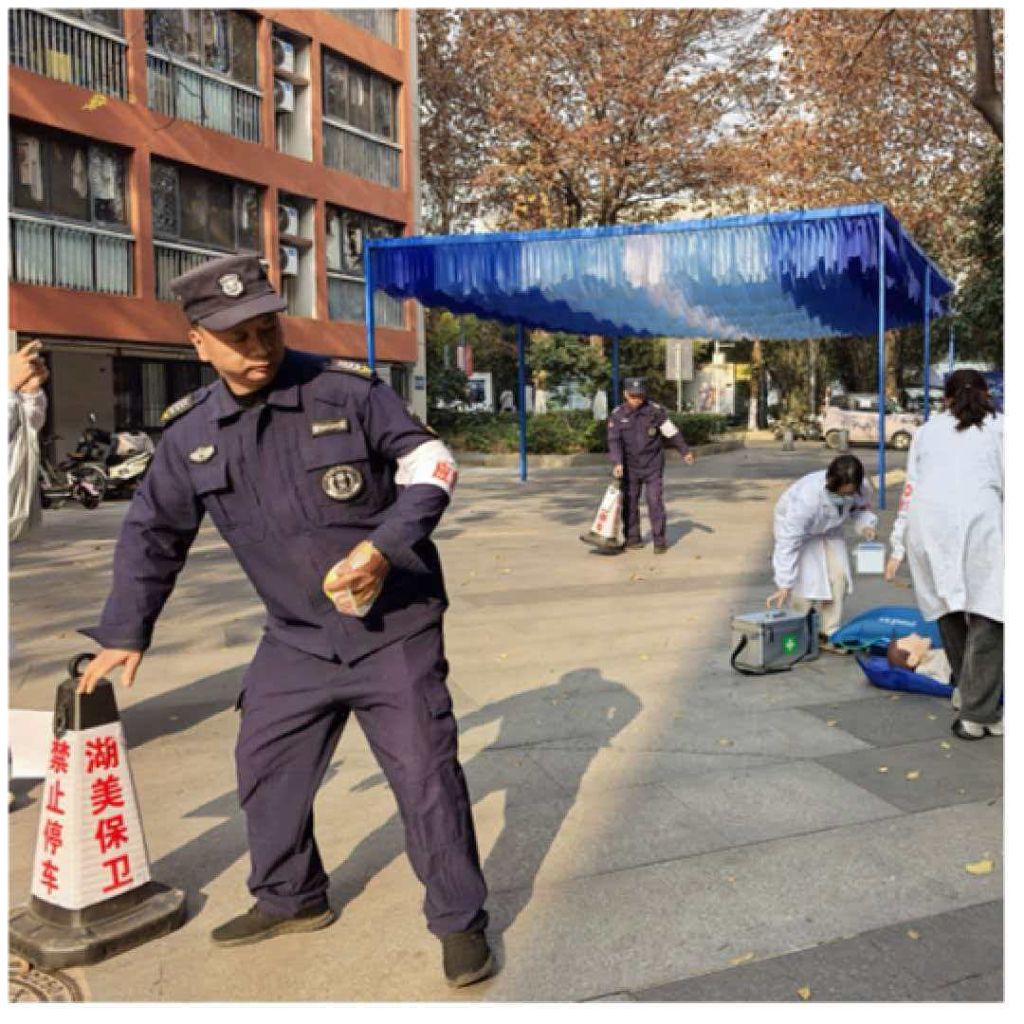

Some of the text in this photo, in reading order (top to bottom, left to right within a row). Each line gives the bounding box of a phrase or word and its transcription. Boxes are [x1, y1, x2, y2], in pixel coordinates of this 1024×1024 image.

[39, 735, 72, 897] 禁止停车
[83, 735, 135, 894] 湖美保卫
